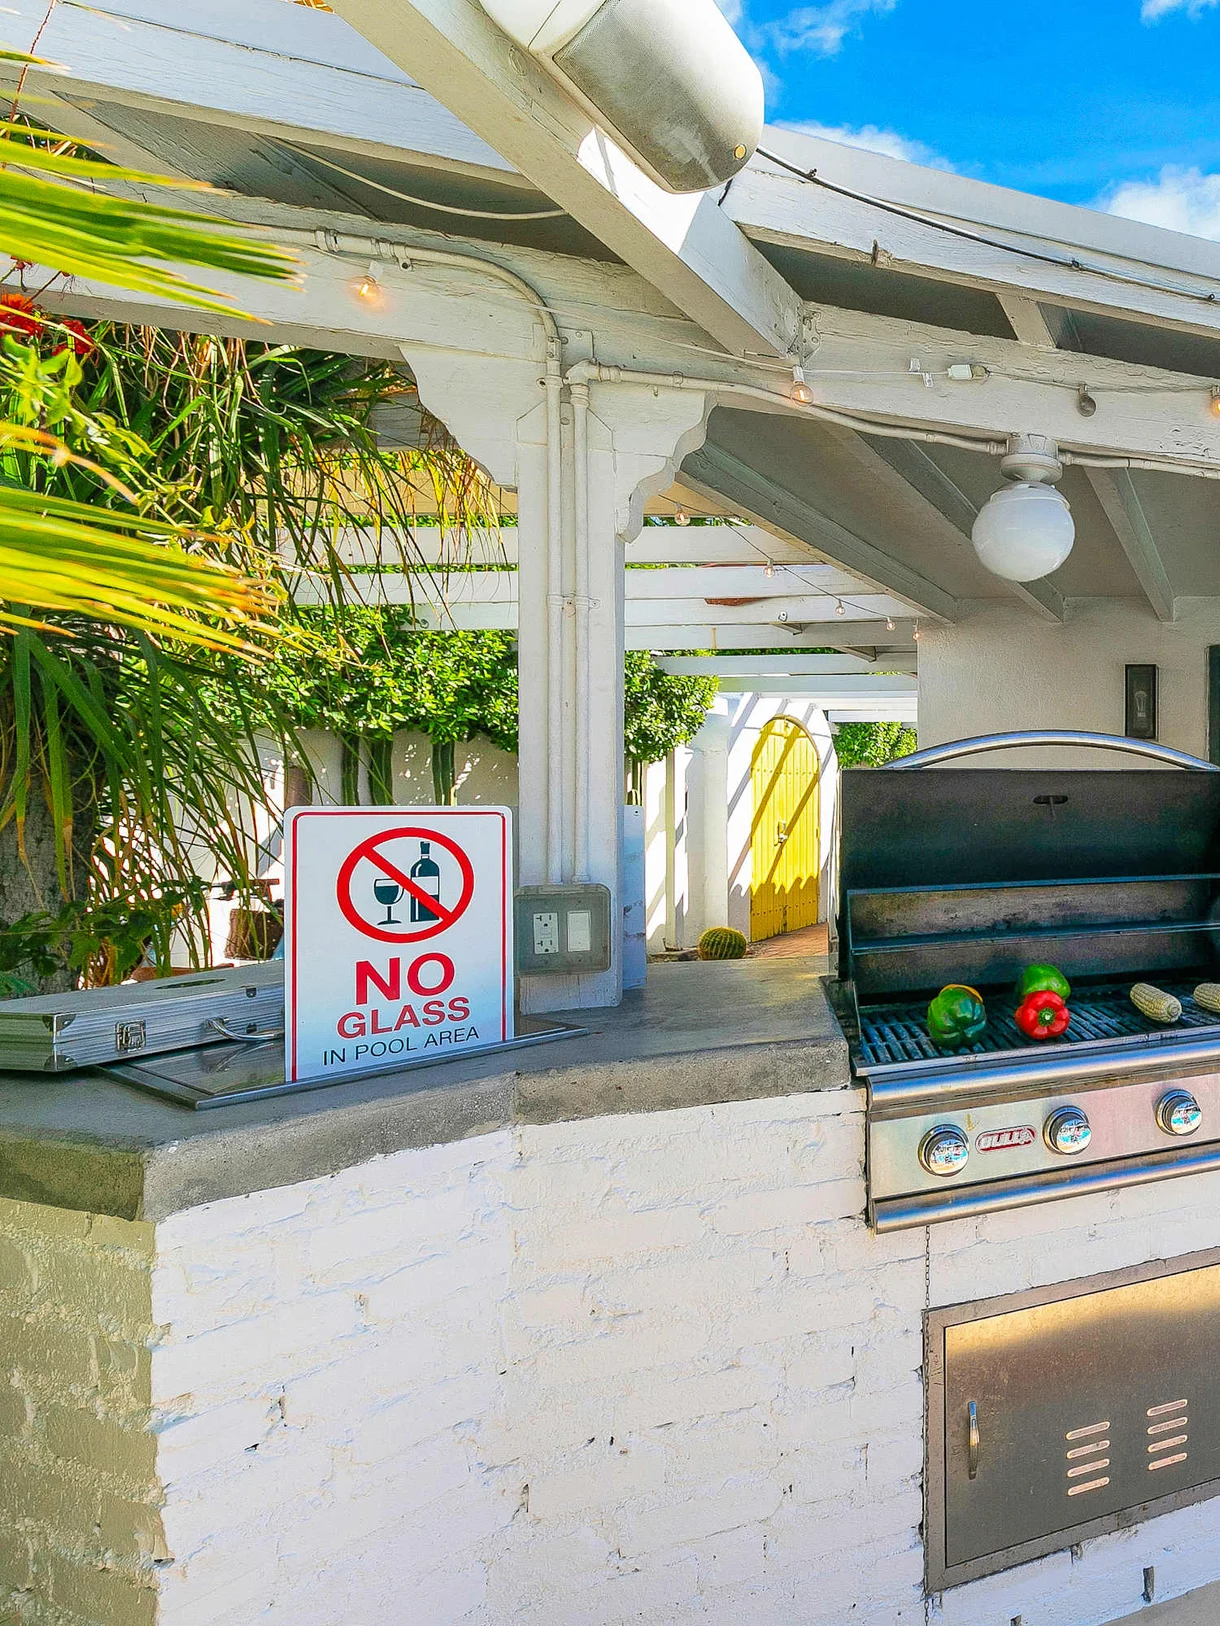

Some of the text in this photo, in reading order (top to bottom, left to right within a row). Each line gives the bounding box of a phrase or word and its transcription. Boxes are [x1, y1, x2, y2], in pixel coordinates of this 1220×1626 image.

[355, 952, 455, 1006] NO
[337, 996, 471, 1040] GLASS
[323, 1026, 480, 1066] IN POOL AREA
